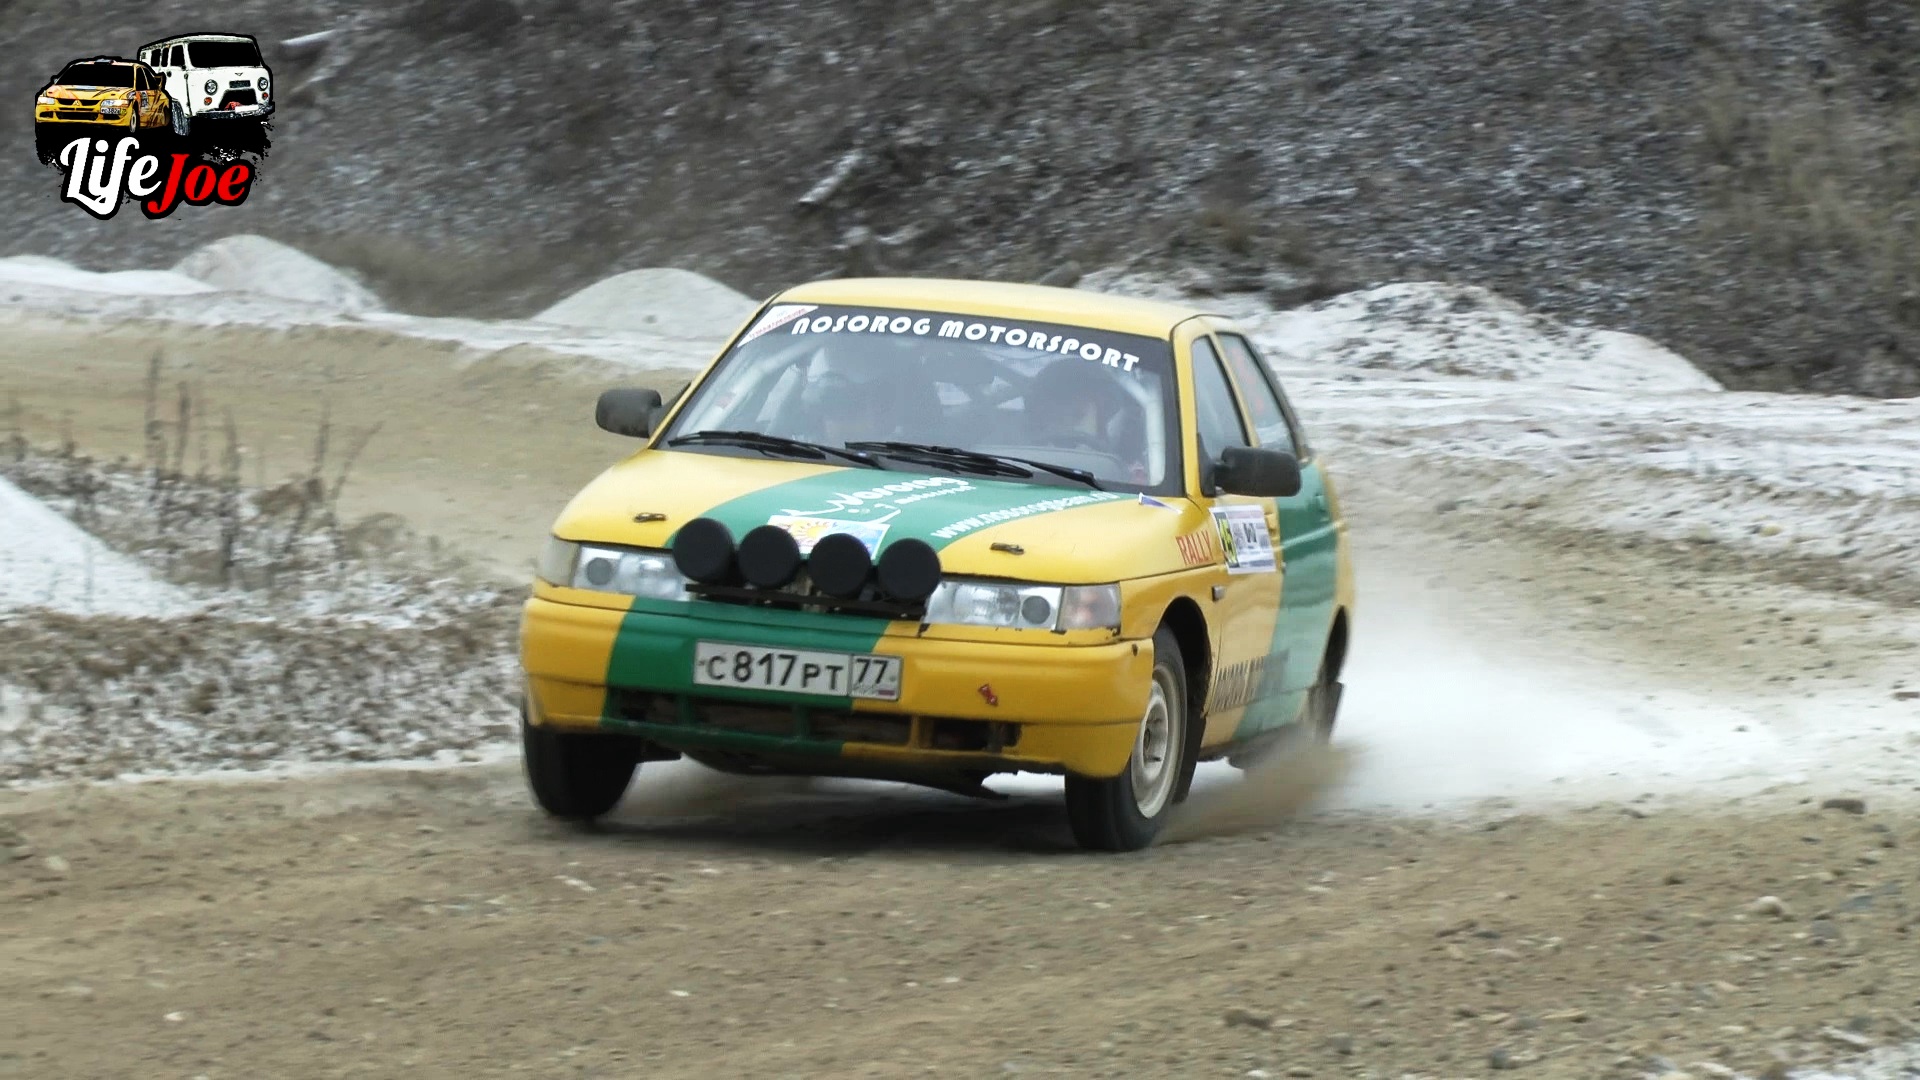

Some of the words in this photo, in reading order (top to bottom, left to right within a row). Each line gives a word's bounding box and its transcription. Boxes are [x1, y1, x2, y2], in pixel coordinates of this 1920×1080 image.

[792, 315, 930, 335] NOSOROG
[938, 320, 1139, 372] MOTORSPORT
[1176, 530, 1213, 566] RALLY
[856, 658, 888, 684] 77
